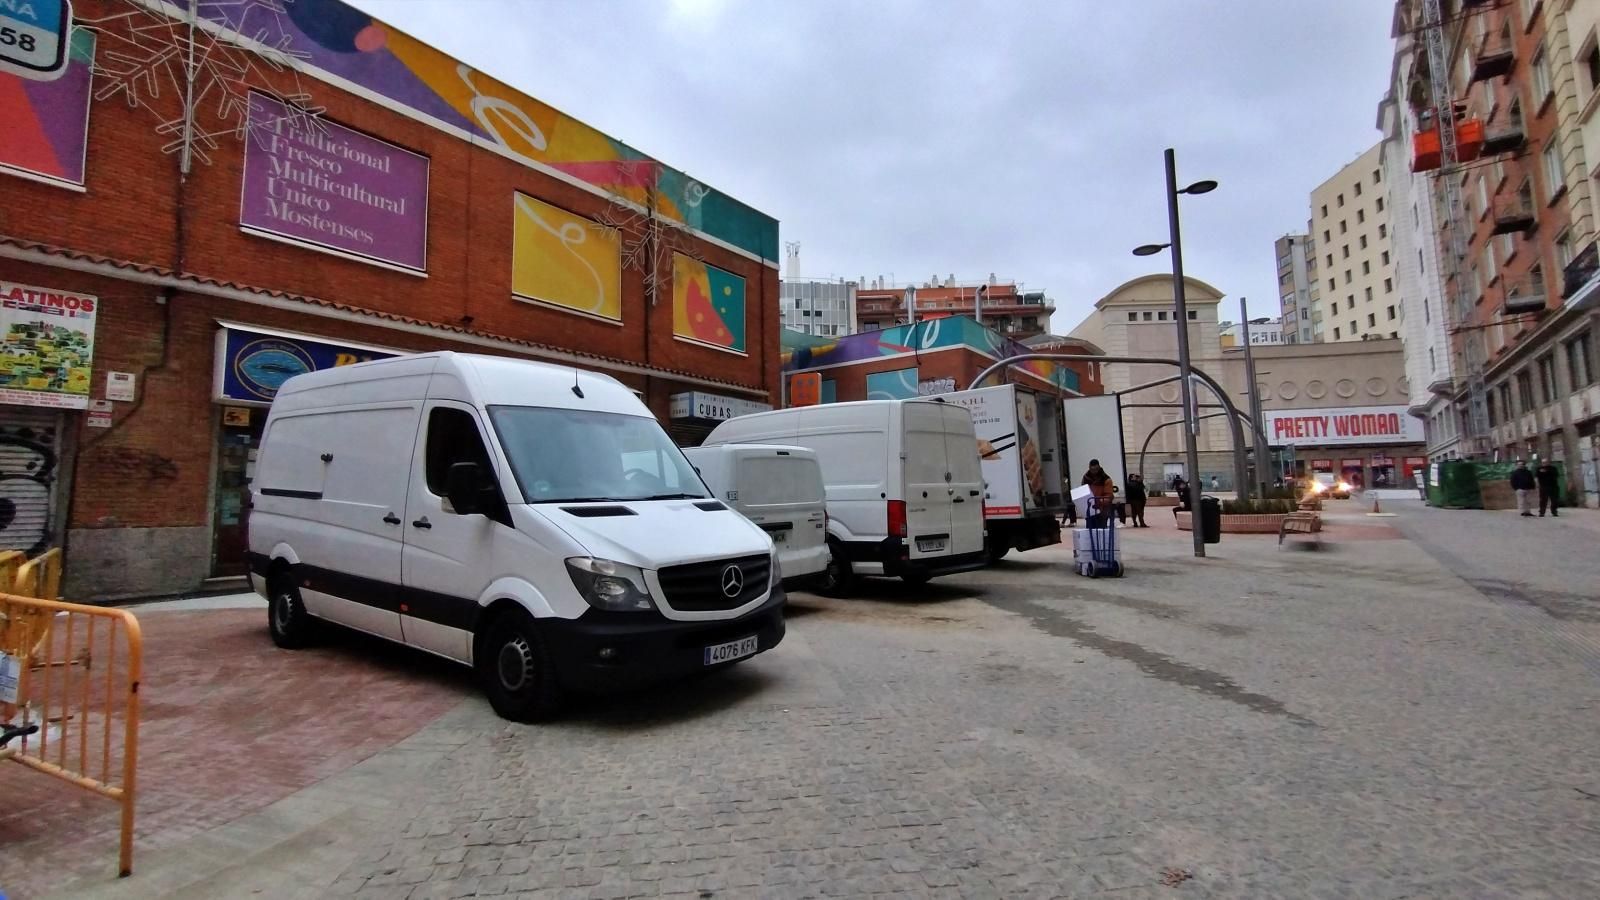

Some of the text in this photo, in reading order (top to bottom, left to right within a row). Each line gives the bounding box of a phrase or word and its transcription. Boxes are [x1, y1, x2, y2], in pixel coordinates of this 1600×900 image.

[0, 26, 36, 52] 58
[268, 113, 390, 174] Tradicional
[269, 134, 343, 175] Fresco
[268, 154, 406, 216] Multicultural
[264, 196, 374, 244] Mostenses
[699, 403, 731, 419] CUBAS
[1273, 416, 1329, 438] PRETTY
[1333, 413, 1400, 436] WOMAN
[712, 643, 739, 660] 4076
